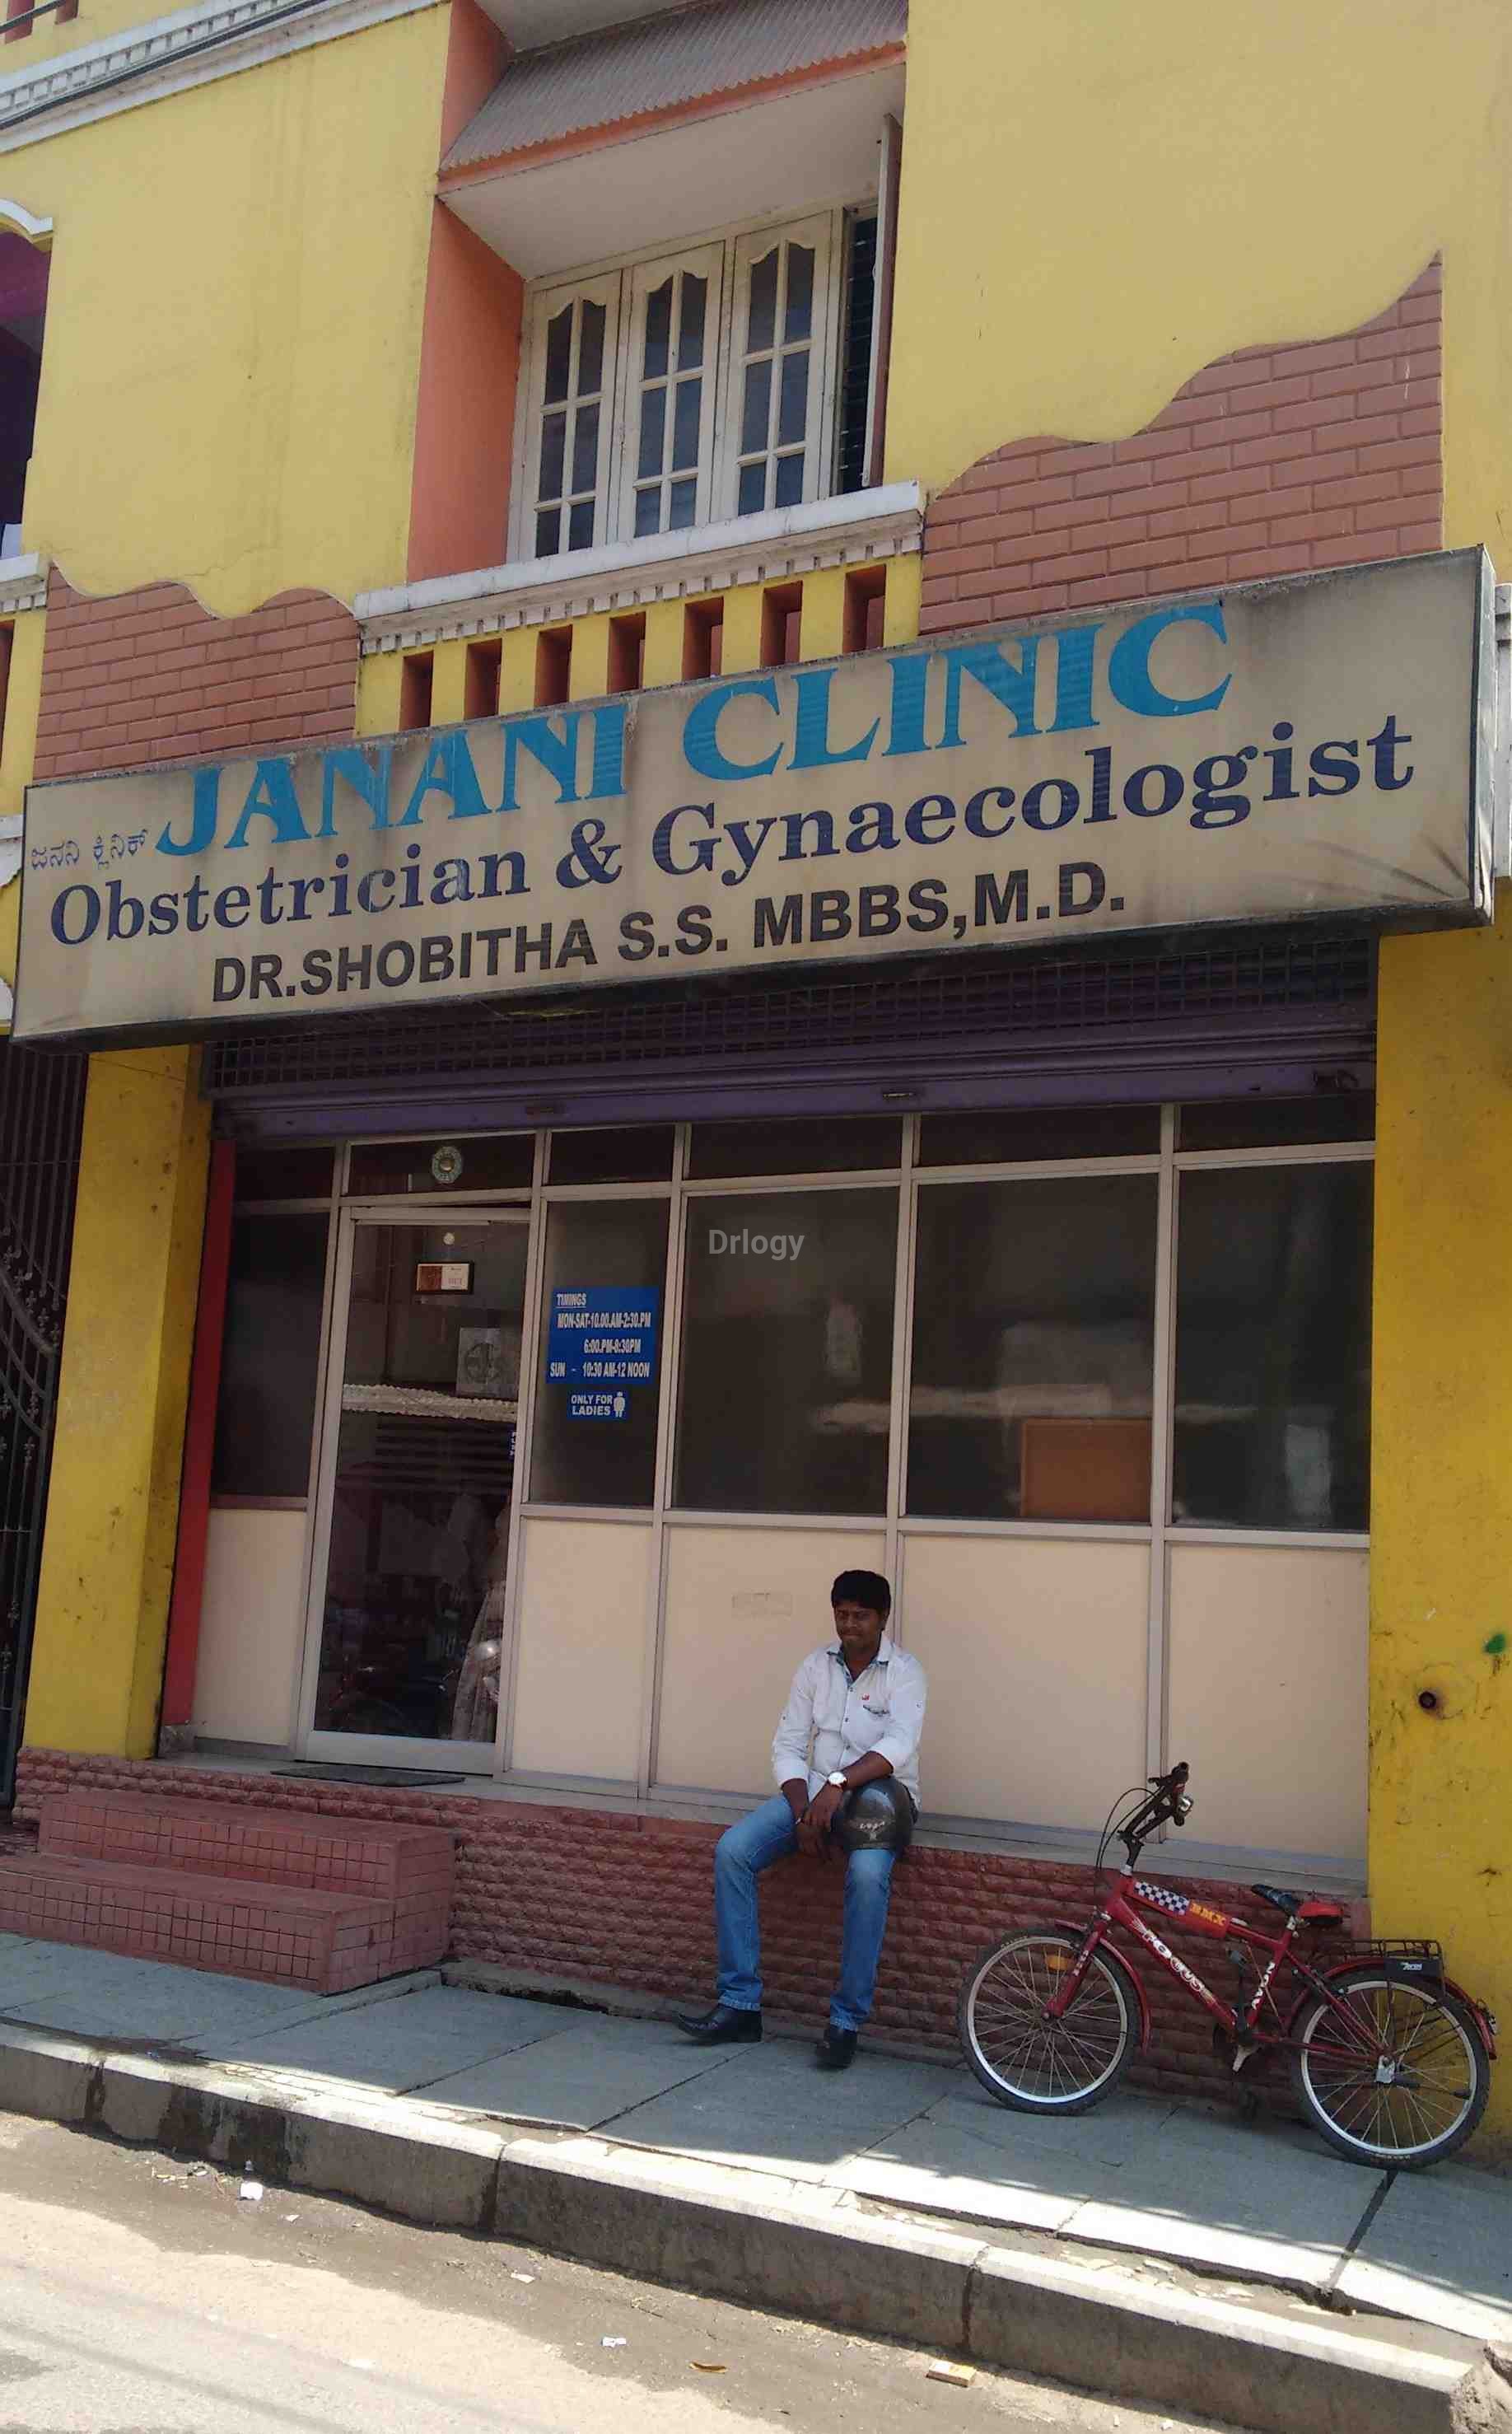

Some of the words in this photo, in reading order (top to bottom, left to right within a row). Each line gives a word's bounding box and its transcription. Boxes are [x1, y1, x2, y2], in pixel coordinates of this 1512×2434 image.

[156, 704, 628, 856] JANANI
[684, 600, 1232, 780] CLINIC
[51, 844, 530, 945] Obstetrician
[556, 819, 622, 889] &
[652, 716, 1413, 886] Gynaecologist
[213, 919, 597, 1002] DR.SHOBITHA
[618, 905, 727, 961] S.S.
[754, 862, 1124, 947] MBBS,M.D.
[556, 1293, 586, 1306] TIMINGS
[550, 1362, 566, 1377] SUN
[583, 1362, 602, 1377] 10:30
[627, 1362, 650, 1377] NOON
[571, 1395, 593, 1404] ONLY
[595, 1395, 613, 1404] FOR
[572, 1405, 610, 1415] LADIES
